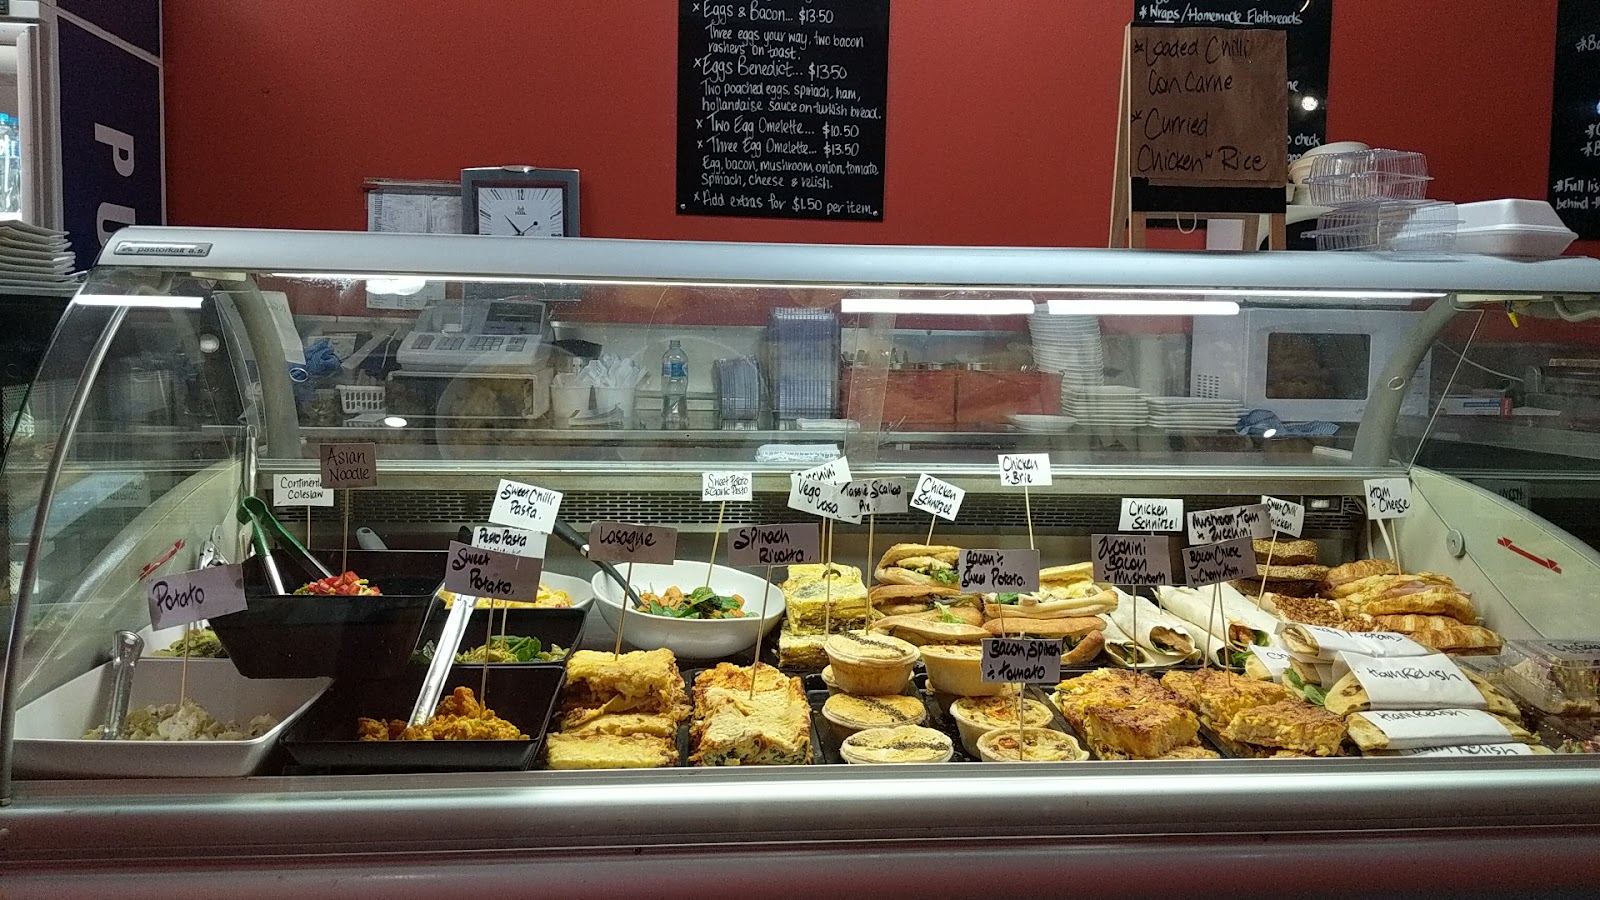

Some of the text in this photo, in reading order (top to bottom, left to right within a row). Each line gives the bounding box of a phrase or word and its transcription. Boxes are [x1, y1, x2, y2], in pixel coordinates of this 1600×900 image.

[703, 0, 734, 25] Eggs
[738, 6, 747, 17] &
[704, 23, 733, 40] Three
[737, 30, 760, 46] eggs
[763, 31, 785, 47] your
[813, 31, 831, 46] two
[833, 35, 864, 48] bacon
[708, 41, 801, 60] rashers on toast.
[1145, 35, 1251, 66] Loaded Chilli
[702, 53, 734, 83] Eggs
[700, 79, 721, 96] Two
[724, 82, 764, 99] poached
[1185, 71, 1233, 93] Carne
[702, 97, 763, 113] hollandaise
[768, 101, 798, 112] sauce
[850, 106, 882, 119] bread.
[706, 110, 730, 132] Two
[733, 115, 754, 139] Egg
[822, 121, 860, 139] $10.50
[1144, 108, 1209, 140] Curried
[706, 133, 738, 153] Three
[742, 139, 761, 158] Egg
[823, 142, 860, 159] $13.50
[1295, 133, 1320, 146] check
[1137, 144, 1203, 172] Chicken
[1217, 145, 1267, 171] Rice
[748, 174, 784, 187] cheese
[1564, 177, 1584, 192] Full
[703, 190, 725, 206] Add
[730, 194, 763, 208] extras
[768, 193, 786, 210] for
[826, 202, 845, 215] per
[1556, 196, 1589, 210] behind
[326, 447, 366, 466] Asian
[1002, 455, 1039, 472] Chicken
[280, 476, 321, 489] Continent
[329, 468, 370, 482] Noodle
[1011, 470, 1033, 485] Brie
[287, 489, 324, 500] Coleslaw
[798, 478, 821, 503] Vego
[841, 481, 869, 497] Tassie
[921, 477, 956, 500] Chicken
[1369, 484, 1391, 499] Ham
[1128, 500, 1168, 517] Chicken
[1378, 497, 1410, 513] Cheese
[599, 526, 657, 552] Lasagne
[734, 527, 790, 550] Spinach
[452, 547, 490, 571] Sweet
[965, 550, 995, 569] Bacon
[1105, 554, 1148, 572] Bacon
[152, 580, 205, 613] Potato
[988, 640, 1025, 658] Bacon
[998, 660, 1046, 681] tomato
